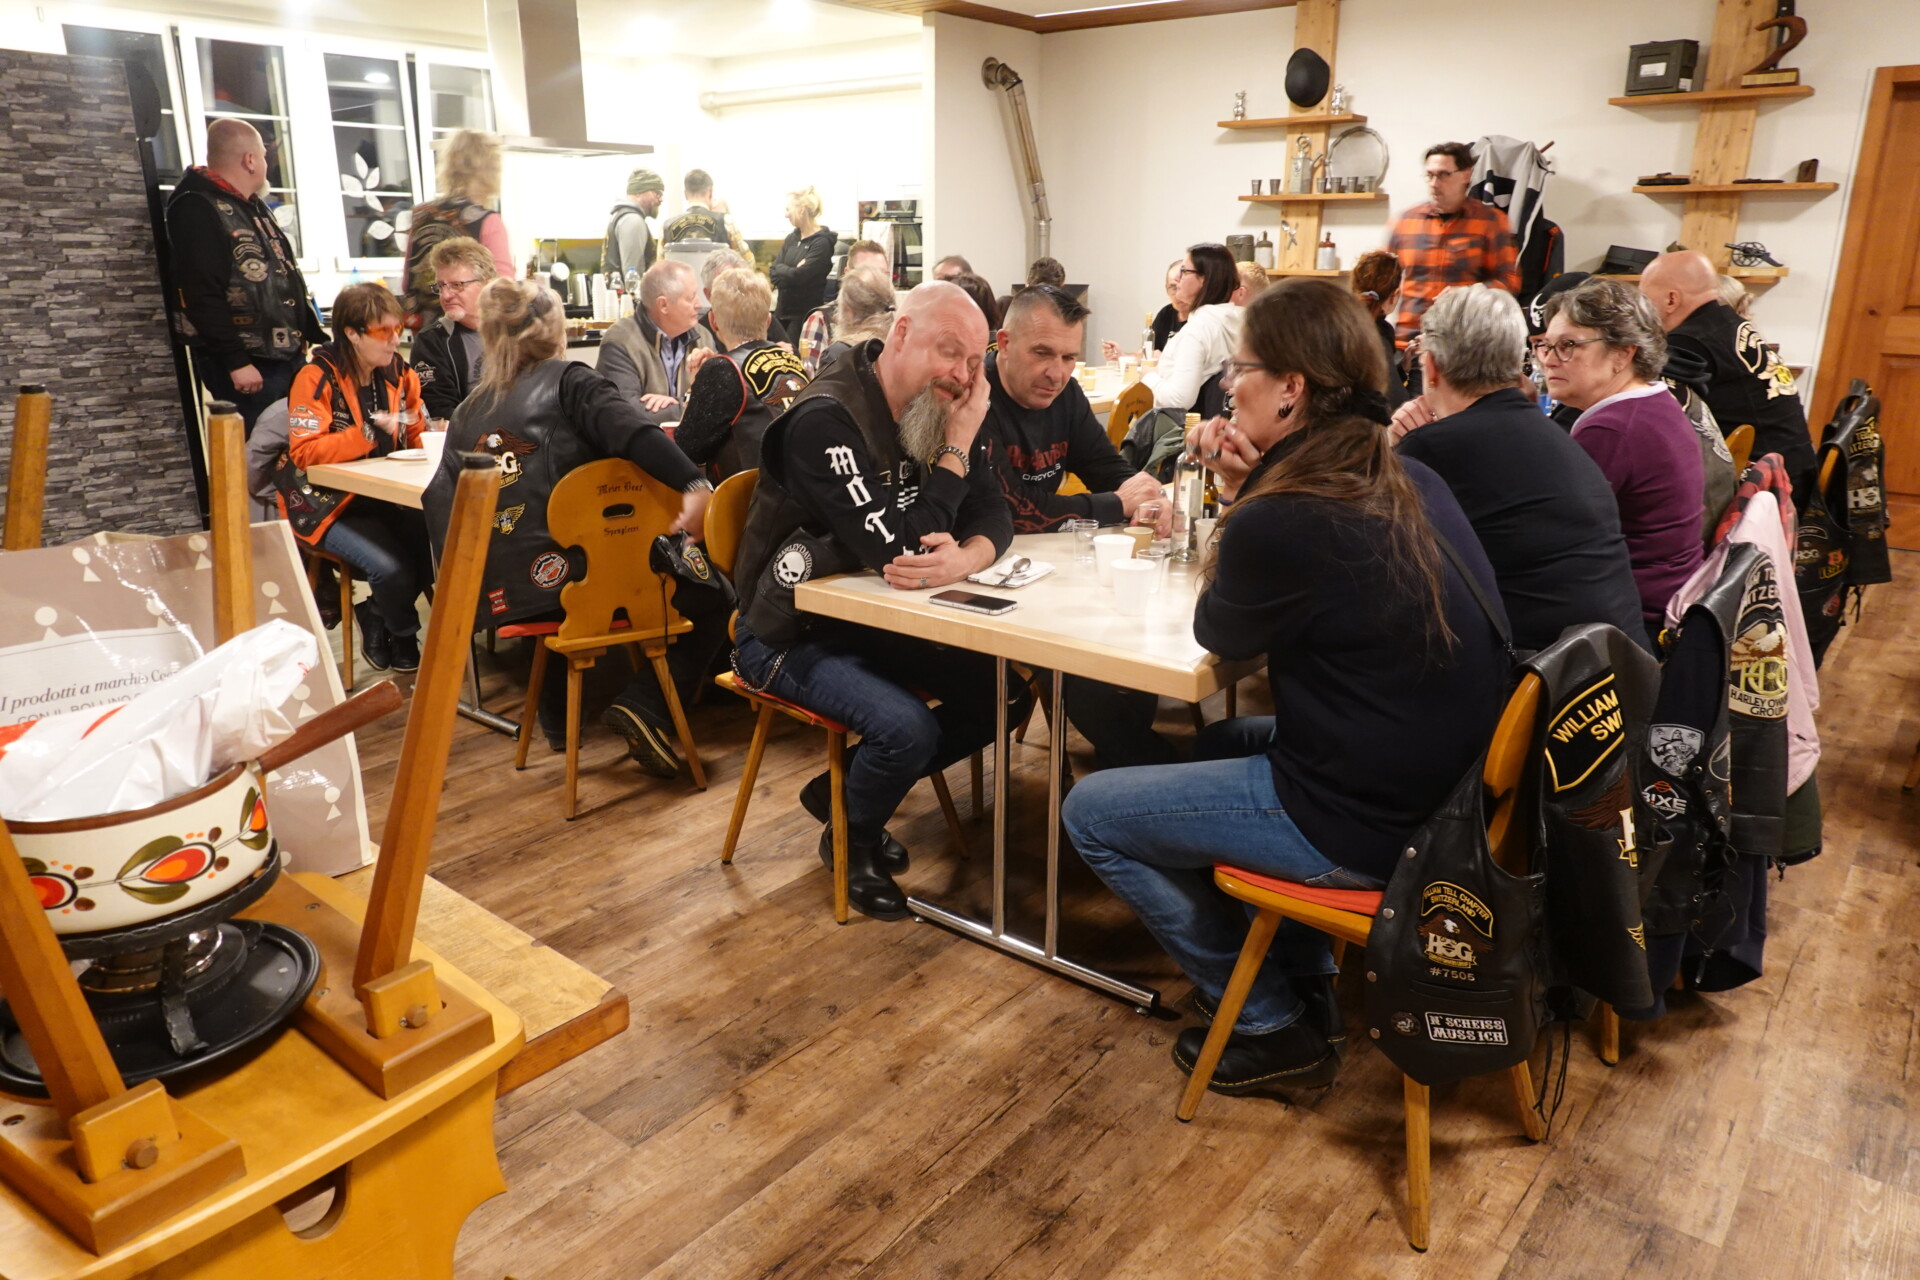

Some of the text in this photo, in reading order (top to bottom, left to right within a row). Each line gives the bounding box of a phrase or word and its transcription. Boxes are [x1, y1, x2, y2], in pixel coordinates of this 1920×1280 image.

[10, 683, 77, 715] prodotti
[80, 684, 90, 695] a
[1730, 688, 1767, 710] HARLEY
[1552, 690, 1619, 743] WILLIAM
[1749, 704, 1785, 718] GROUP
[1442, 886, 1458, 899] TELL
[1459, 893, 1490, 921] CHAPTER
[1429, 966, 1476, 982] #7505
[1445, 1017, 1503, 1031] SCHEISS
[1432, 1026, 1505, 1043] MUSS ICH
